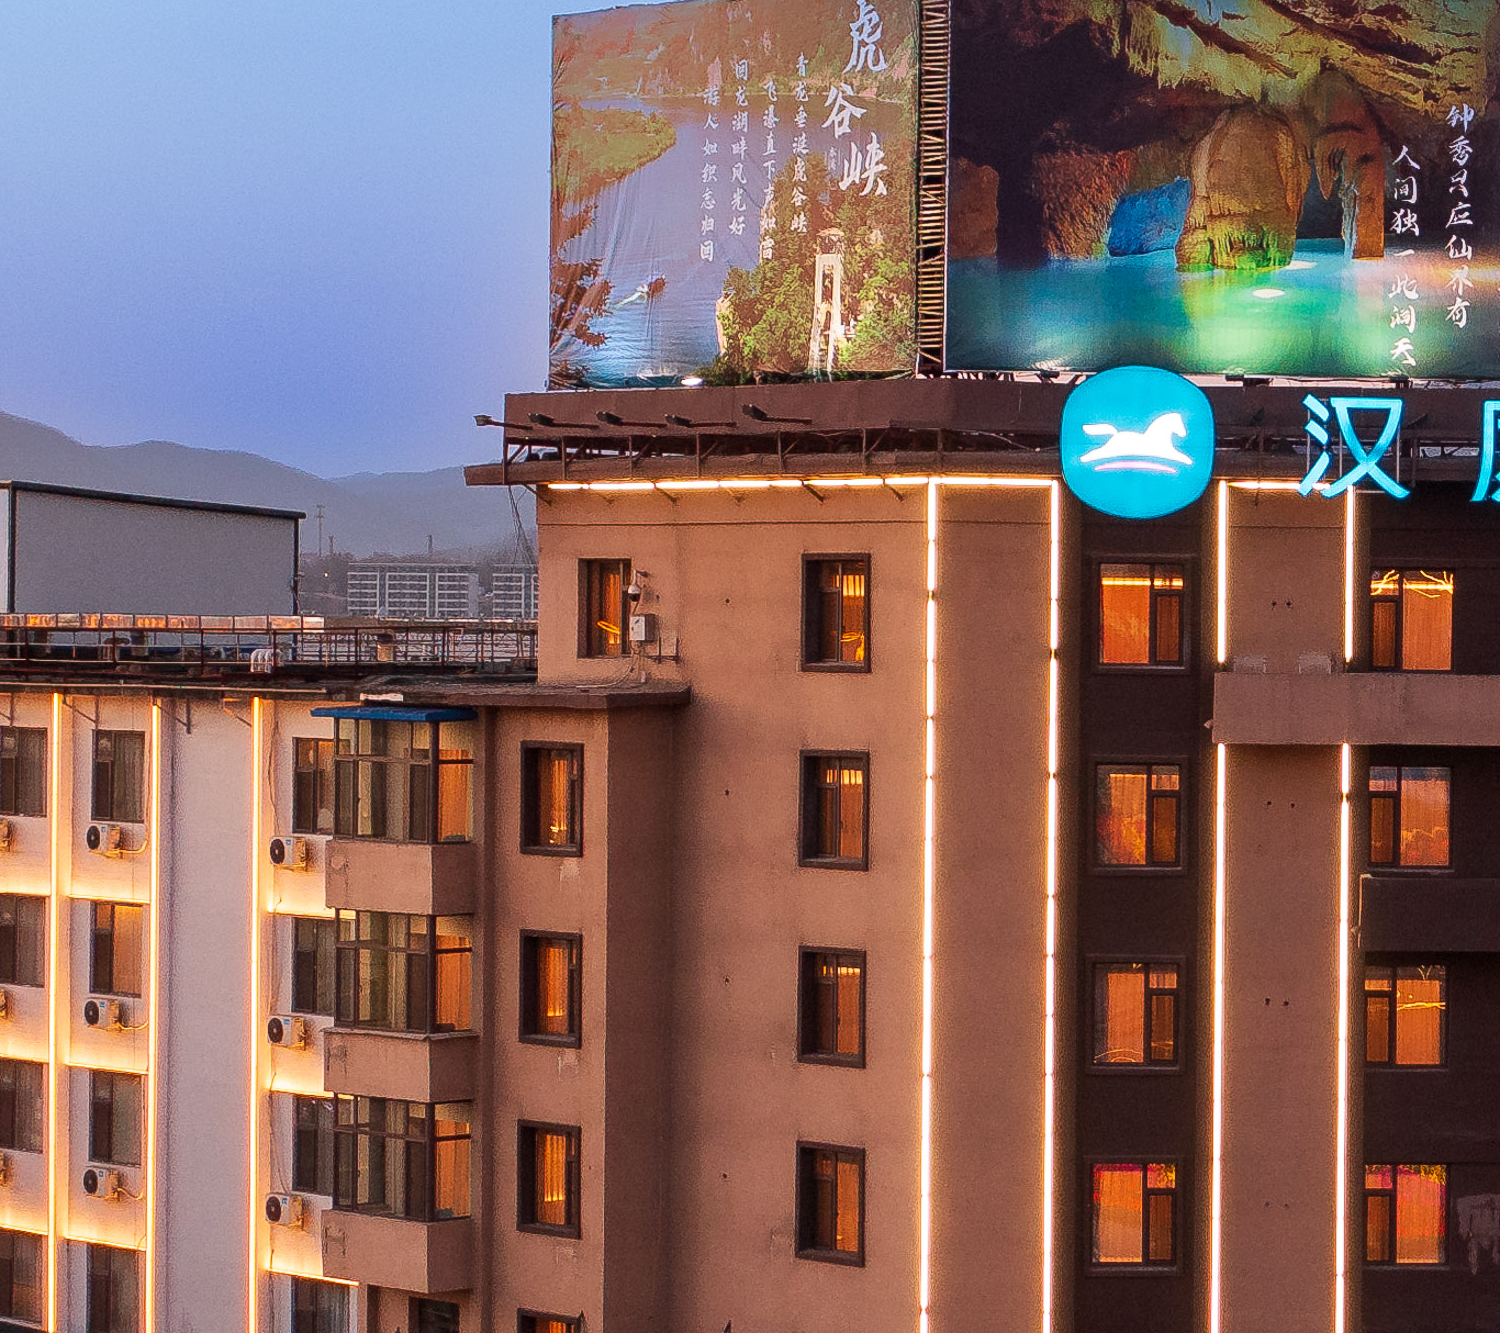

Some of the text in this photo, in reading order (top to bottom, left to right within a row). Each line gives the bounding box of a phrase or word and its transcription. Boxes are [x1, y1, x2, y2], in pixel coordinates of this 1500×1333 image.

[1388, 144, 1422, 367] 人间独一此洞天
[1444, 104, 1475, 329] 钟秀只应仙界有
